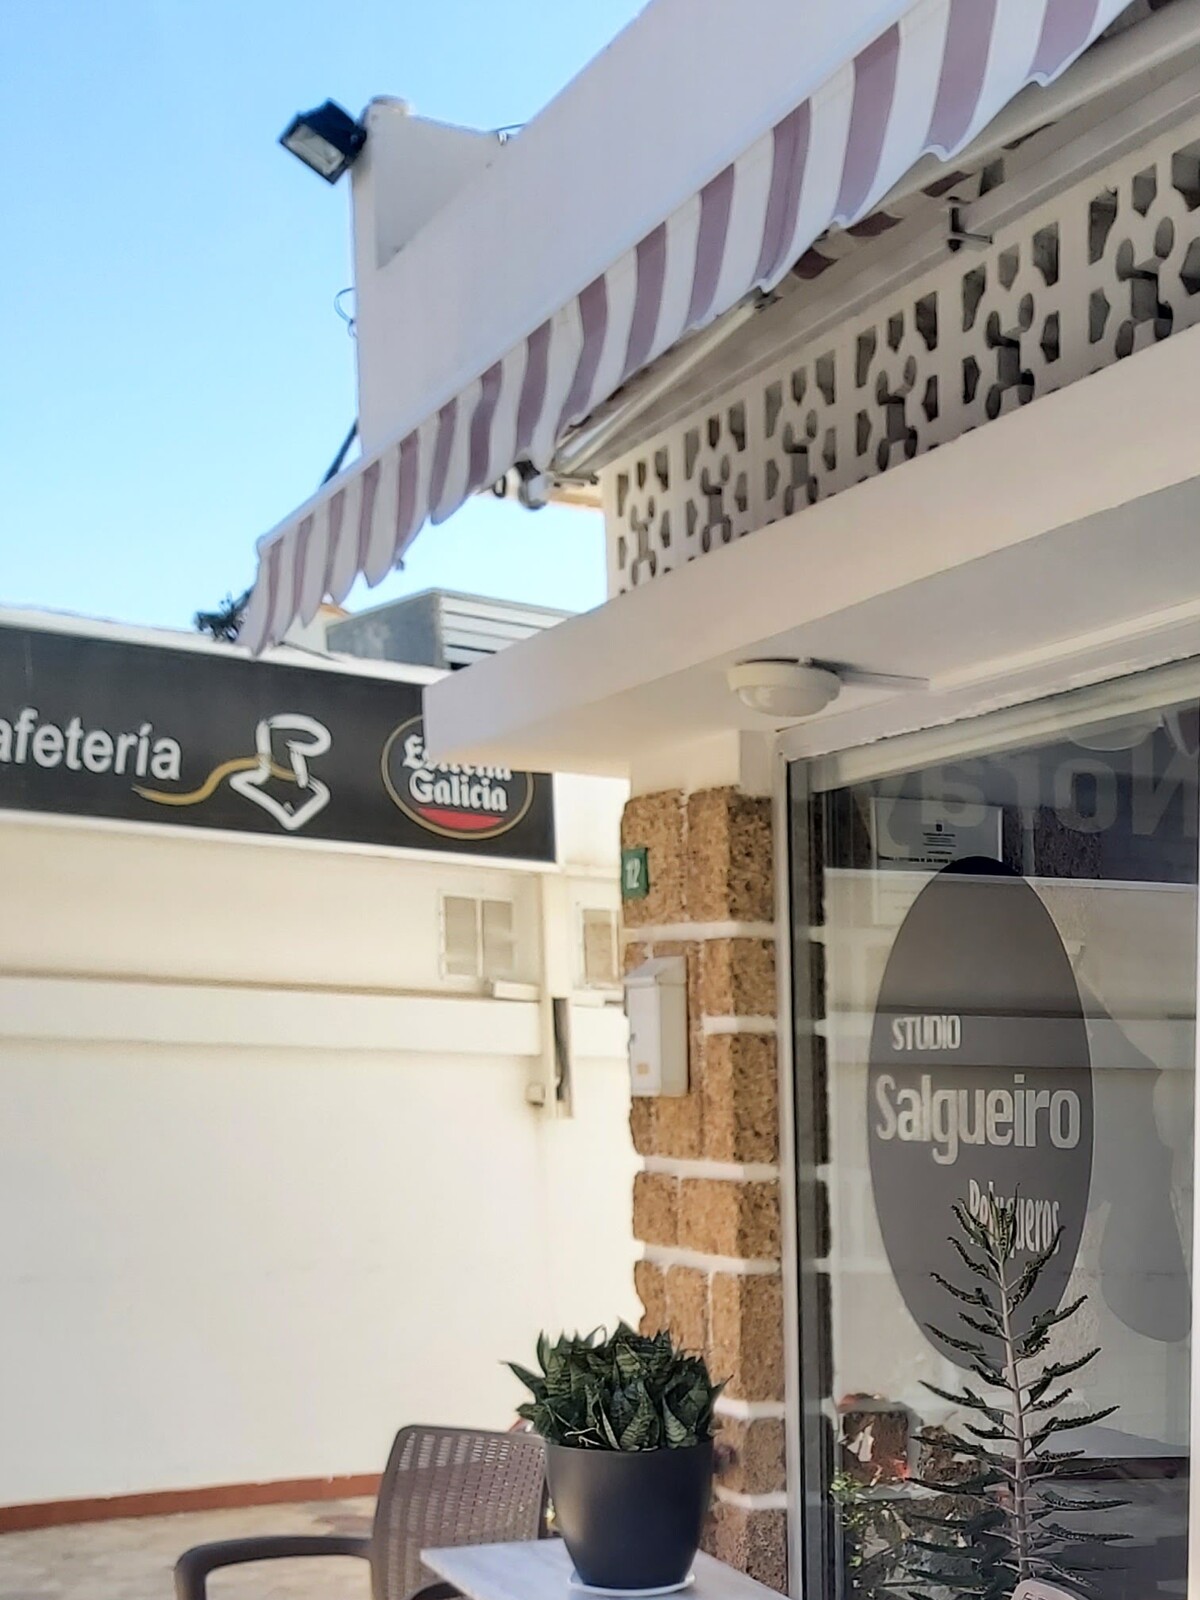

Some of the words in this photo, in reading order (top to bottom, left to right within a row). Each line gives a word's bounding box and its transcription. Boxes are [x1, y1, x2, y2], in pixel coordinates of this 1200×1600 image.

[409, 769, 508, 812] Galicia
[892, 1015, 961, 1050] STUDIO
[876, 1073, 1081, 1165] Salgueiro
